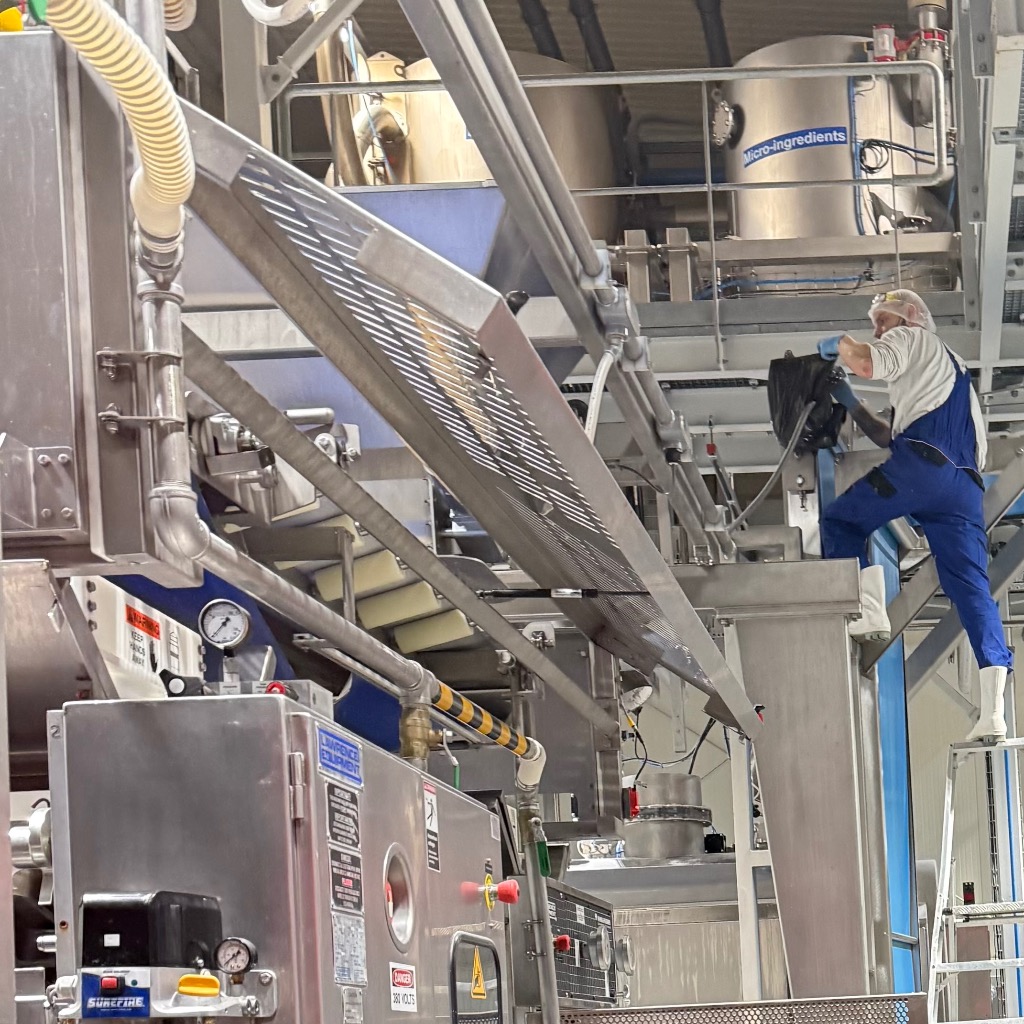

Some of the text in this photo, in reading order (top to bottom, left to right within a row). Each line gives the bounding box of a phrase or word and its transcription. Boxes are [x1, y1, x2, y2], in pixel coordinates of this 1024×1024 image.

[743, 130, 846, 165] Micro-ingredients
[50, 725, 61, 739] 2
[321, 735, 360, 762] LAWRENCE
[321, 749, 360, 776] EQUIPMENT
[394, 971, 412, 984] DANGER
[87, 996, 144, 1009] SUREFIRE
[401, 993, 415, 1005] VOLTS
